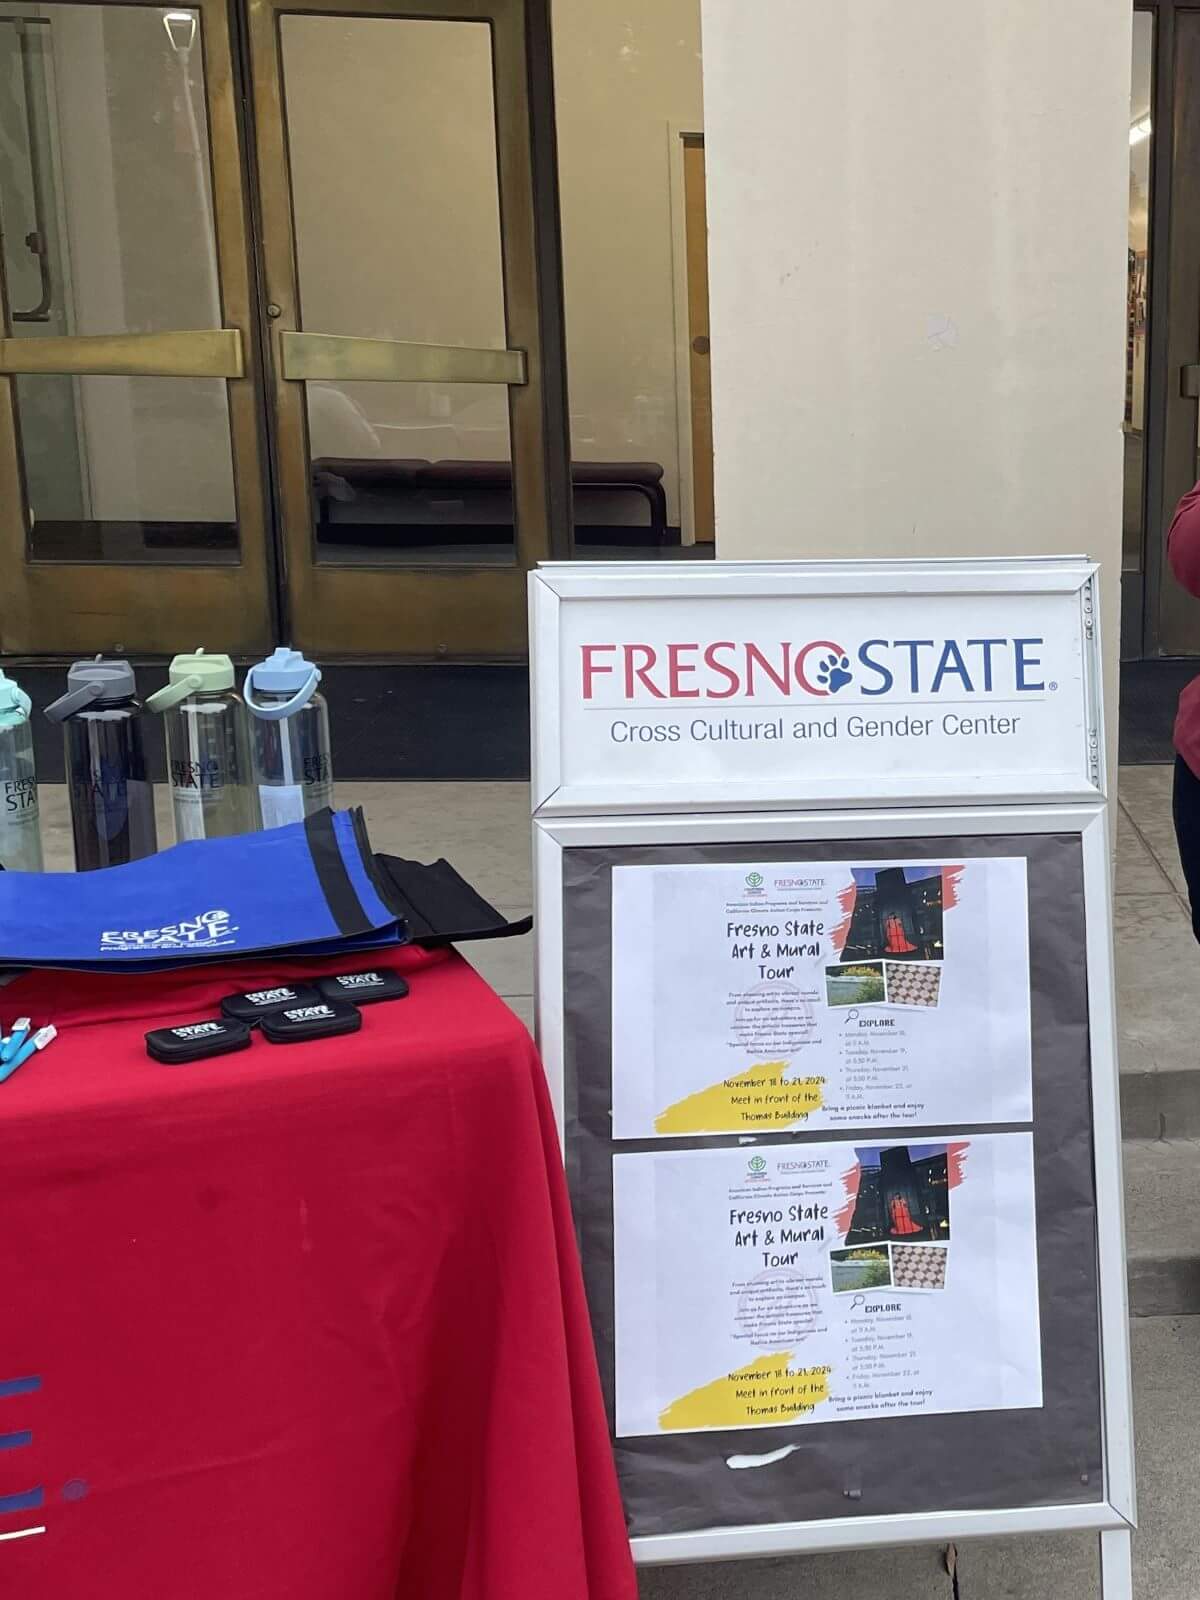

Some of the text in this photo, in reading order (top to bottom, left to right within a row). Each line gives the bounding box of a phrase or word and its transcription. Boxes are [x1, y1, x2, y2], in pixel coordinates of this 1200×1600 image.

[579, 638, 1046, 699] FRESNO STATE
[610, 713, 1021, 743] Cross Cultural and Gender Center
[774, 878, 825, 887] FRESNO STATE
[102, 910, 230, 939] FRESNO
[727, 919, 824, 938] Fresno State
[732, 941, 820, 960] Art & Mural
[758, 964, 795, 980] Tour
[723, 1078, 766, 1088] November
[780, 1077, 790, 1086] to
[805, 1075, 825, 1085] 2024
[731, 1092, 818, 1105] Meet in front of the
[741, 1110, 809, 1123] Thomas Building
[777, 1160, 829, 1170] FRESNO STATE
[730, 1203, 829, 1226] Fresno State
[735, 1225, 824, 1247] Art & Mural
[762, 1251, 799, 1268] Tour
[728, 1371, 771, 1381] November
[785, 1368, 795, 1377] to
[811, 1366, 832, 1376] 2024
[736, 1383, 824, 1399] Meet in front of the
[746, 1402, 815, 1416] Thomas Building
